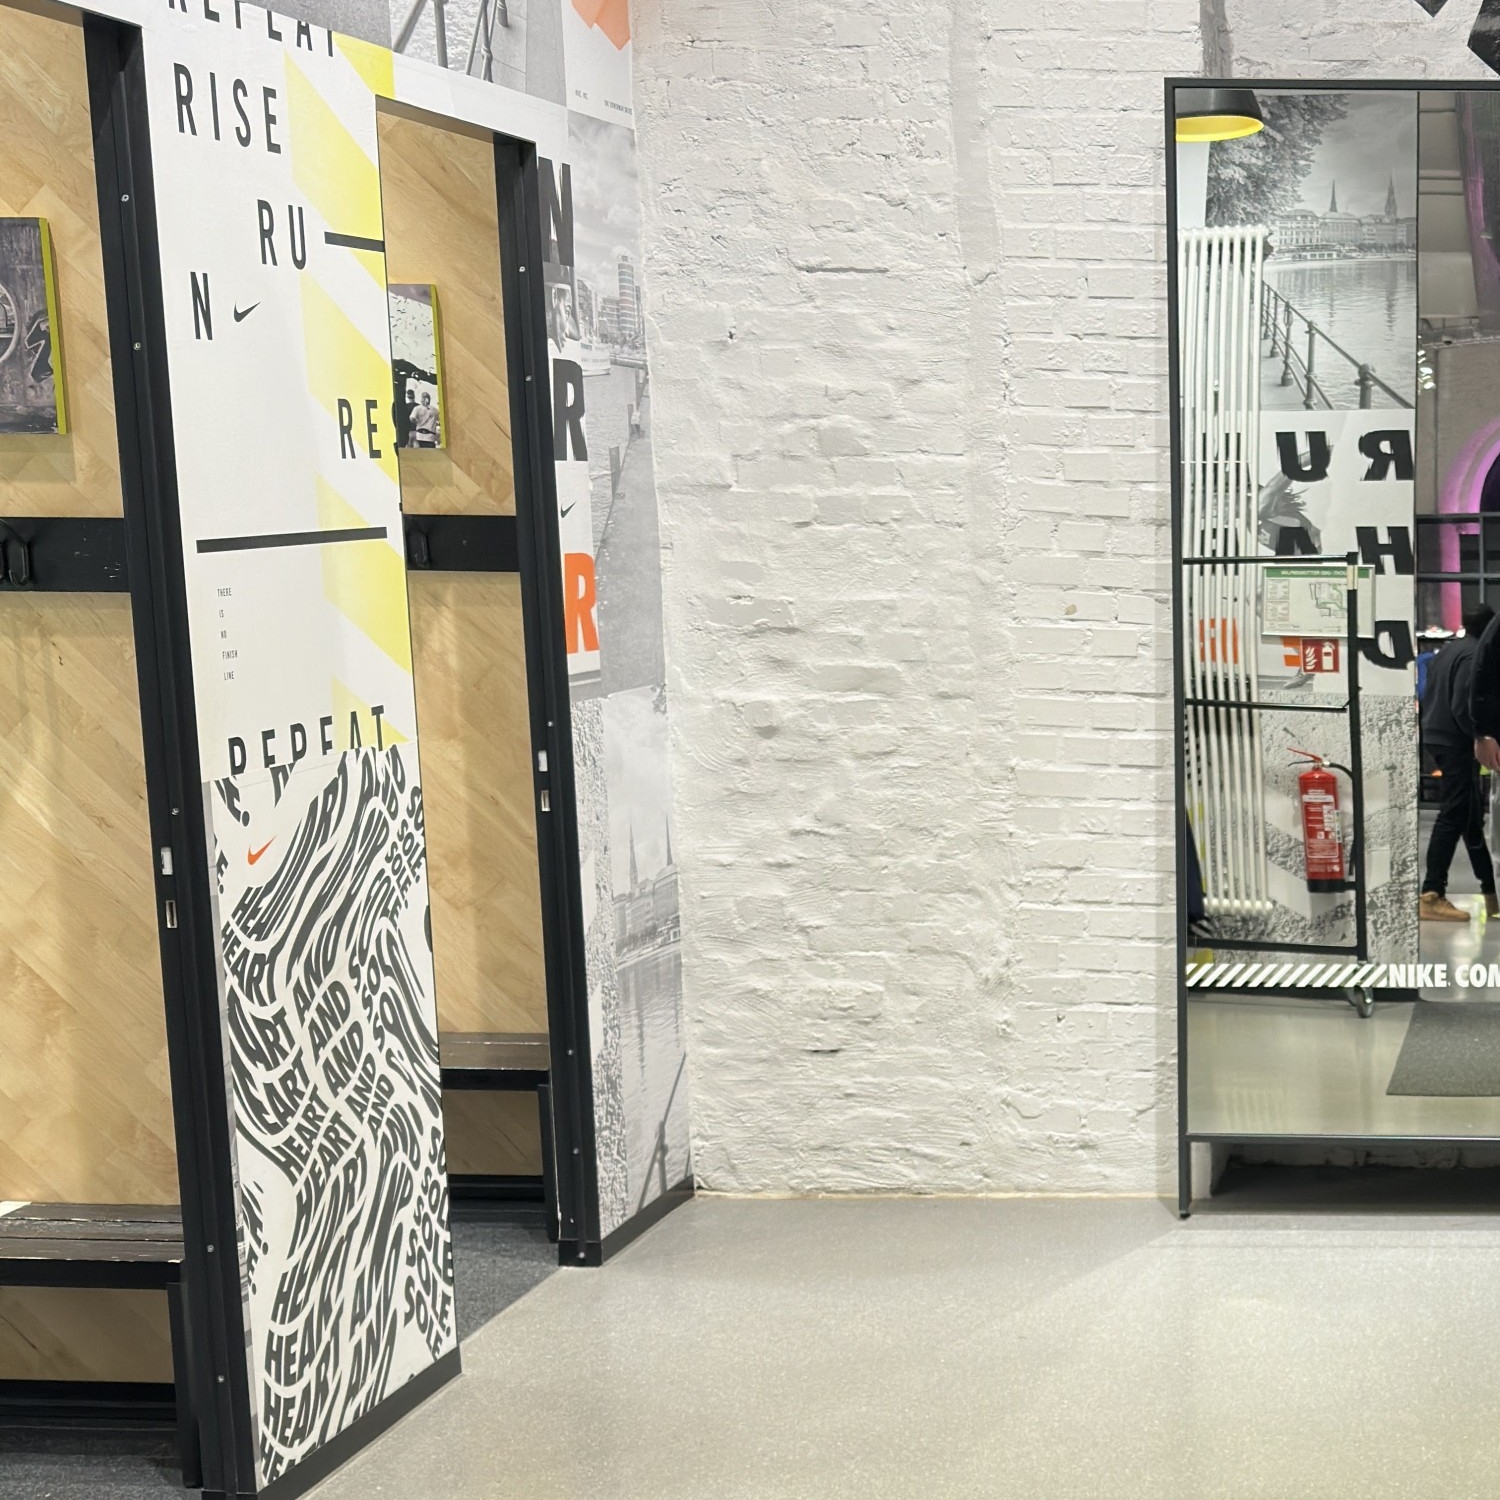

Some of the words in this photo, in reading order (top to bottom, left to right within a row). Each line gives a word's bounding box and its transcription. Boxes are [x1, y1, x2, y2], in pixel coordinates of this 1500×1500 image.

[173, 62, 282, 154] RISE
[217, 588, 232, 597] THERE
[218, 609, 224, 618] IS
[222, 650, 238, 660] FINISH
[223, 671, 235, 681] LINE
[308, 981, 351, 1066] AND
[322, 1021, 364, 1098] AND
[345, 1053, 377, 1125] AND
[286, 1110, 357, 1260] HEART
[367, 1074, 395, 1148] AND
